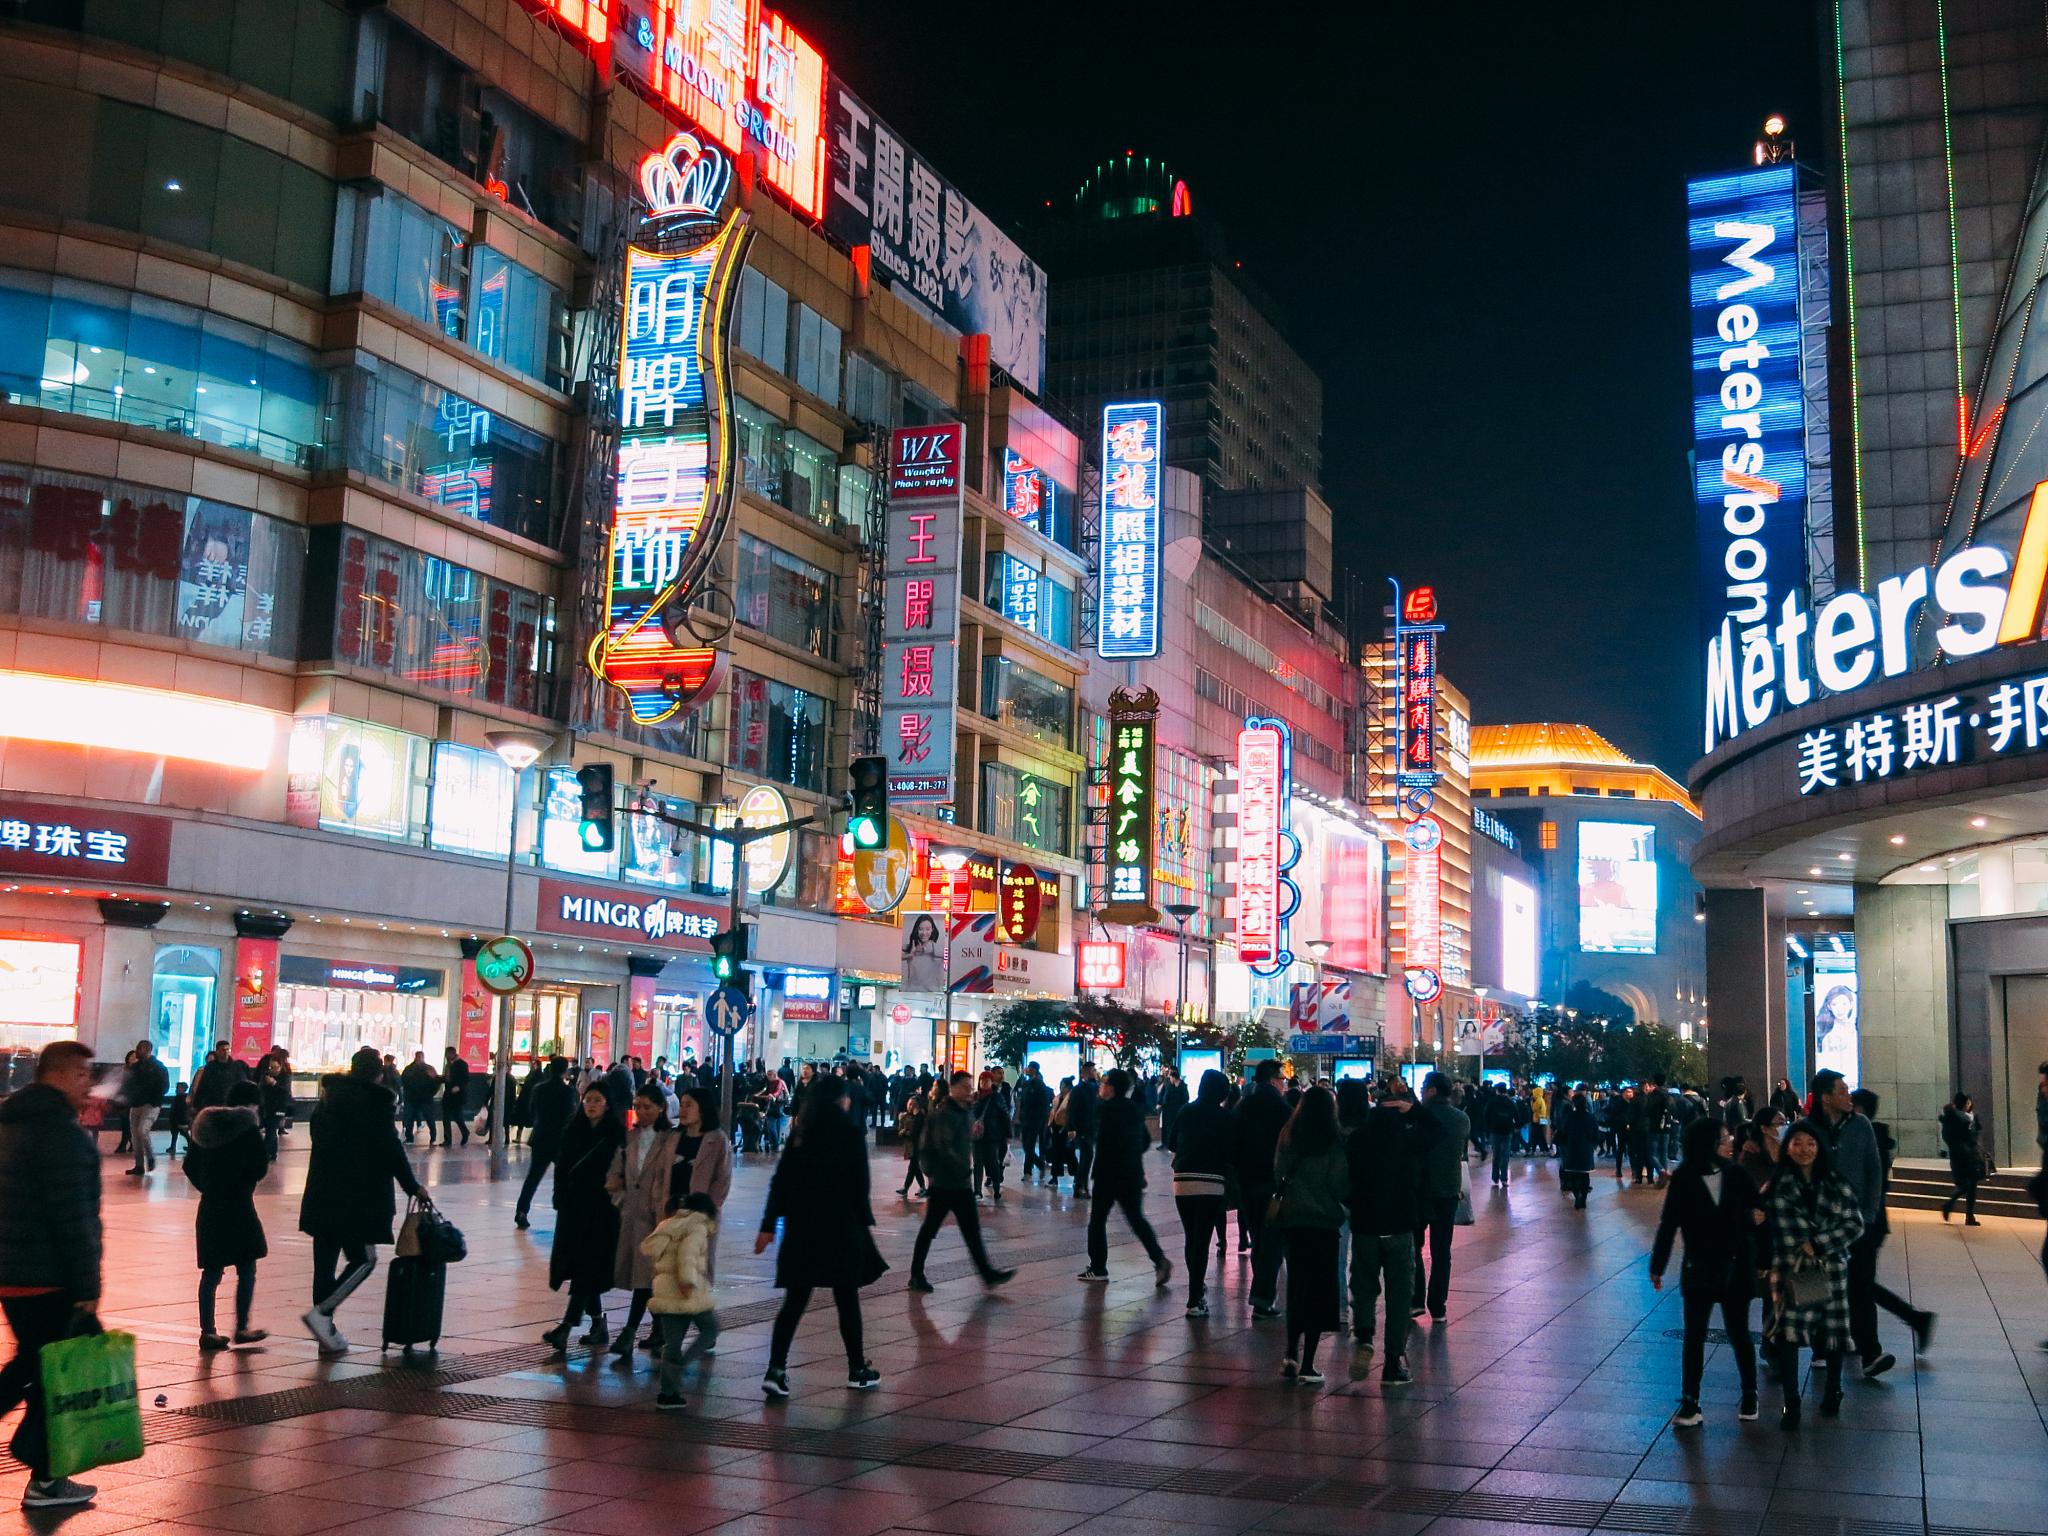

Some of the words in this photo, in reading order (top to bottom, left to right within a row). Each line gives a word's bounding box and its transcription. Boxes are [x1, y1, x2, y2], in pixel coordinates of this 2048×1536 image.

[637, 17, 654, 52] &
[663, 38, 728, 111] MOON
[734, 99, 798, 166] GROUP
[870, 229, 910, 281] Since
[912, 264, 945, 311] 1921
[614, 273, 696, 595] 明牌首饰
[902, 434, 951, 462] WK
[904, 465, 945, 477] Wangkai
[562, 895, 641, 929] MINGR
[1084, 946, 1117, 964] UNI
[1241, 944, 1271, 952] OPTICAL
[1083, 965, 1119, 985] QLO
